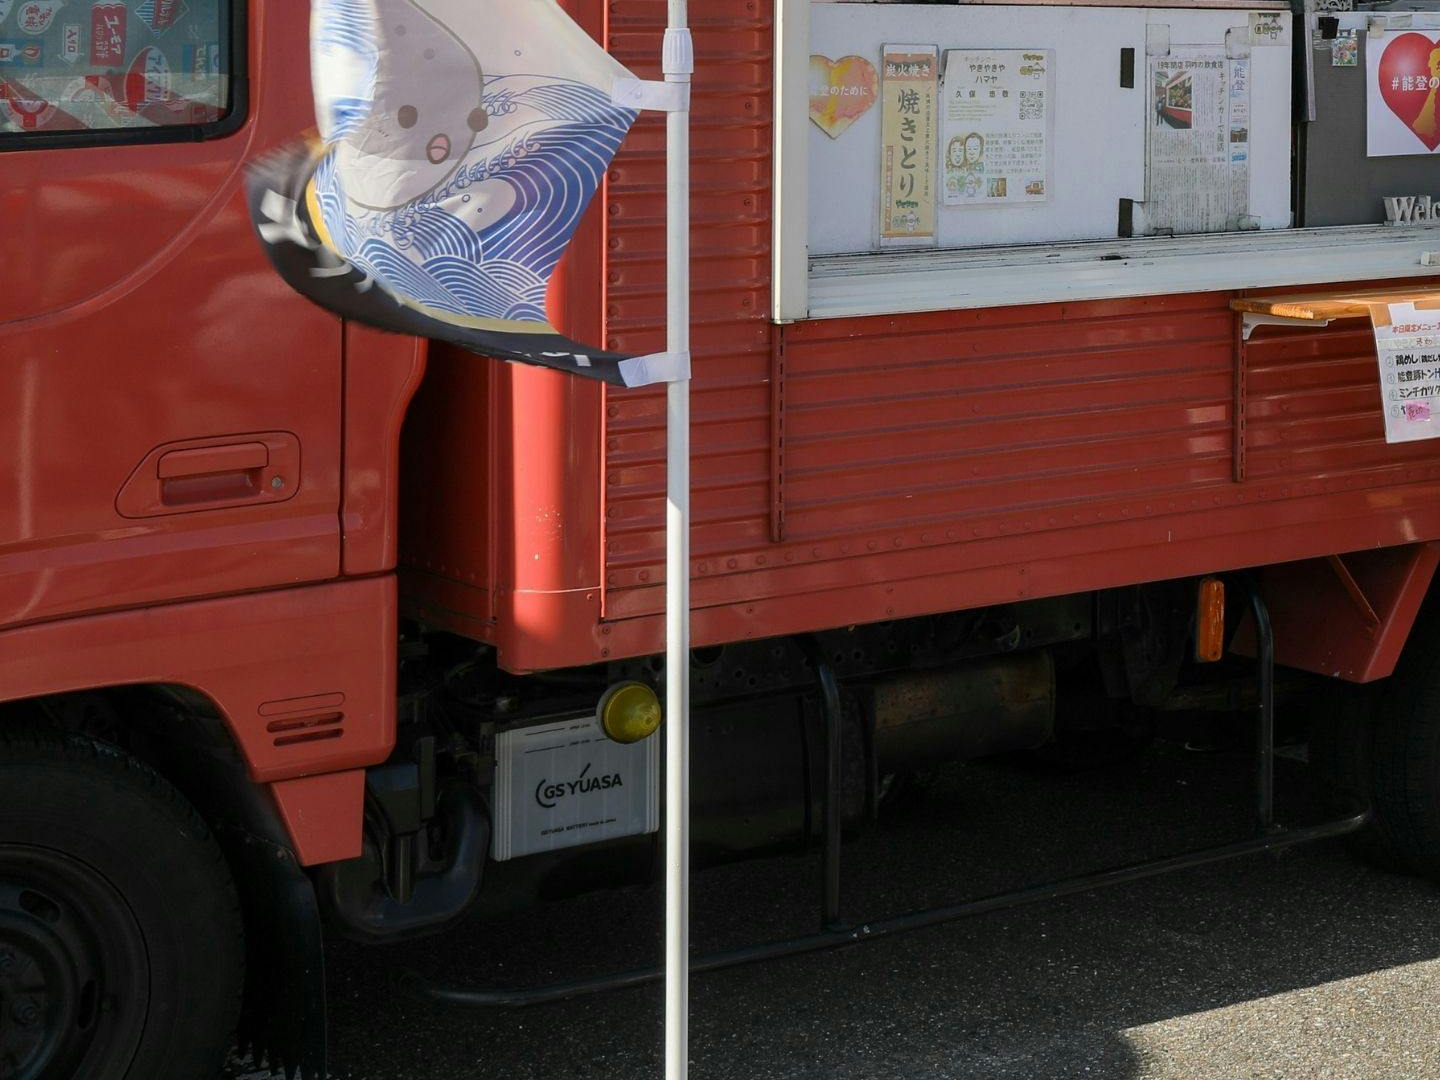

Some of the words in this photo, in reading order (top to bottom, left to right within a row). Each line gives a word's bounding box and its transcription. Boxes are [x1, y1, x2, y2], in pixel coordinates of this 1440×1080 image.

[103, 15, 122, 55] ユーモア
[886, 63, 930, 78] 炭火焼き
[969, 64, 1006, 73] やきやきや
[975, 75, 998, 84] ハマヤ
[1233, 67, 1245, 91] 能登
[898, 89, 920, 198] 焼きとり
